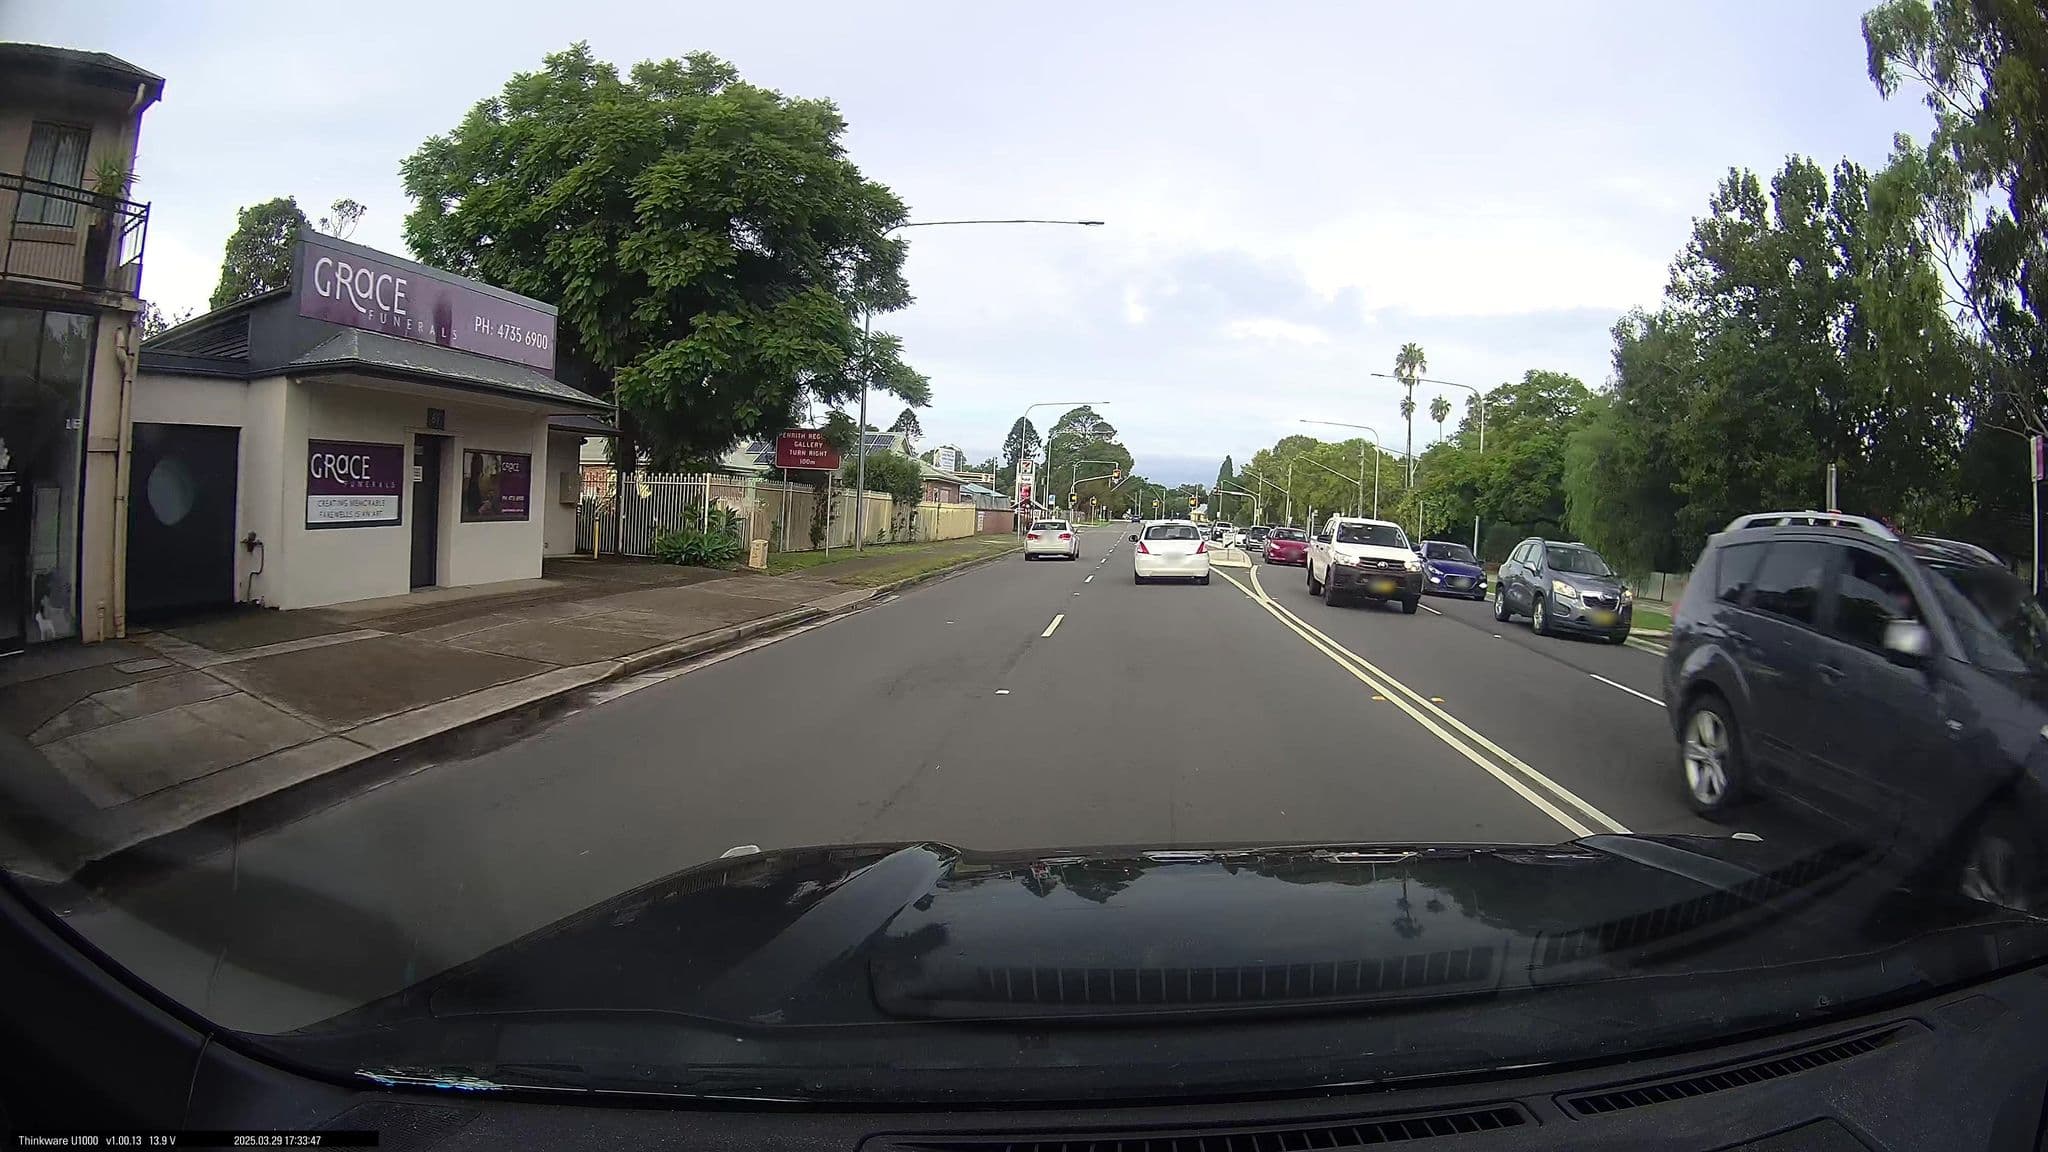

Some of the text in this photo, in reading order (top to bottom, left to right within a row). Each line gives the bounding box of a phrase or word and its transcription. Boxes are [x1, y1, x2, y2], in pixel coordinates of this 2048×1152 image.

[368, 309, 457, 340] FUNERALS
[475, 316, 548, 350] PH: 4735 6900
[794, 441, 824, 449] GALLERY
